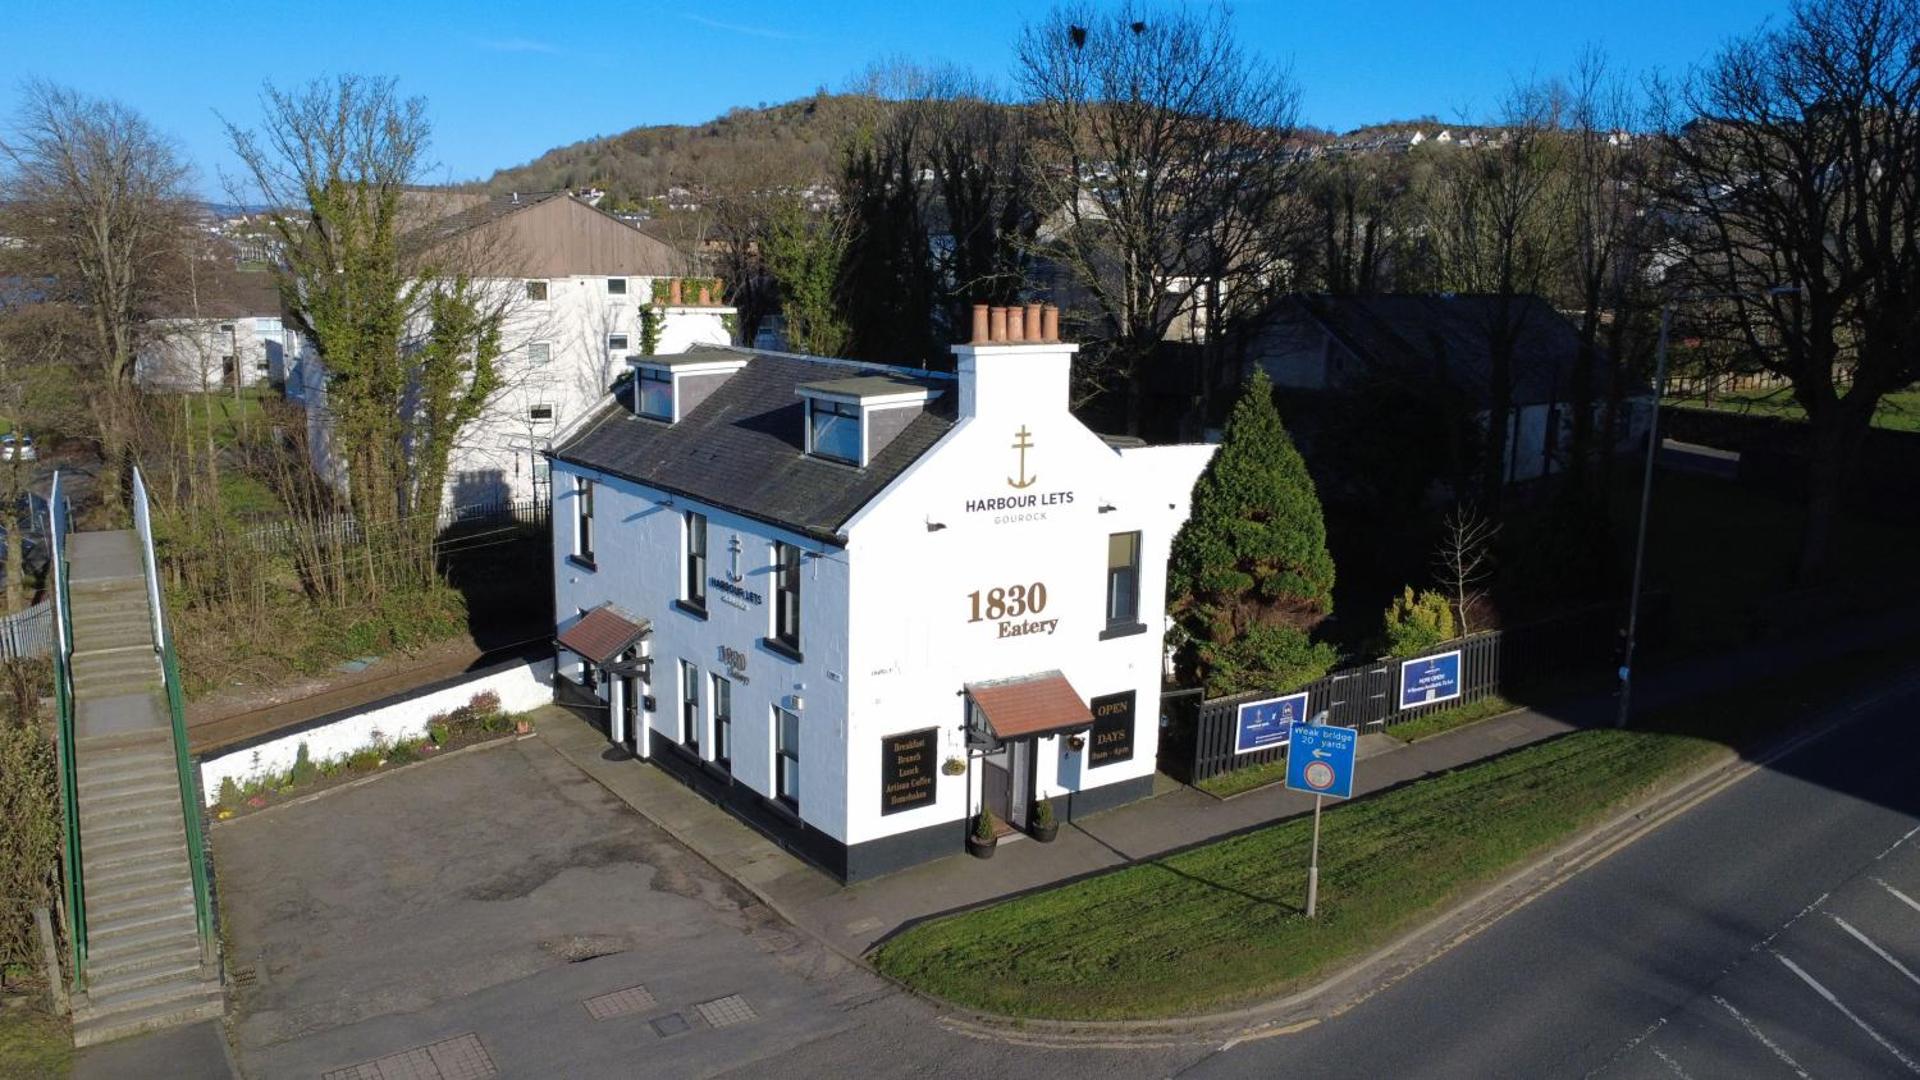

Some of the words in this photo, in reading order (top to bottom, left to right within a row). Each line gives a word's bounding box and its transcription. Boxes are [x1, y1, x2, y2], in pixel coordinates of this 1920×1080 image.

[965, 494, 1037, 512] HARBOUR
[1040, 491, 1074, 506] LETS
[994, 512, 1047, 525] GOUROCK
[967, 582, 1047, 623] 1830
[997, 616, 1059, 639] Eatery
[1097, 701, 1128, 717] OPEN
[1097, 730, 1126, 745] DAYS
[1294, 727, 1319, 737] Weak
[1322, 730, 1353, 742] bridge
[894, 737, 925, 752] Breakfast
[1301, 736, 1314, 745] 20
[1321, 739, 1347, 750] yards
[897, 753, 921, 764] Brunch
[899, 765, 919, 777] Lunch
[886, 781, 910, 793] Artisan
[910, 777, 932, 788] Coffee
